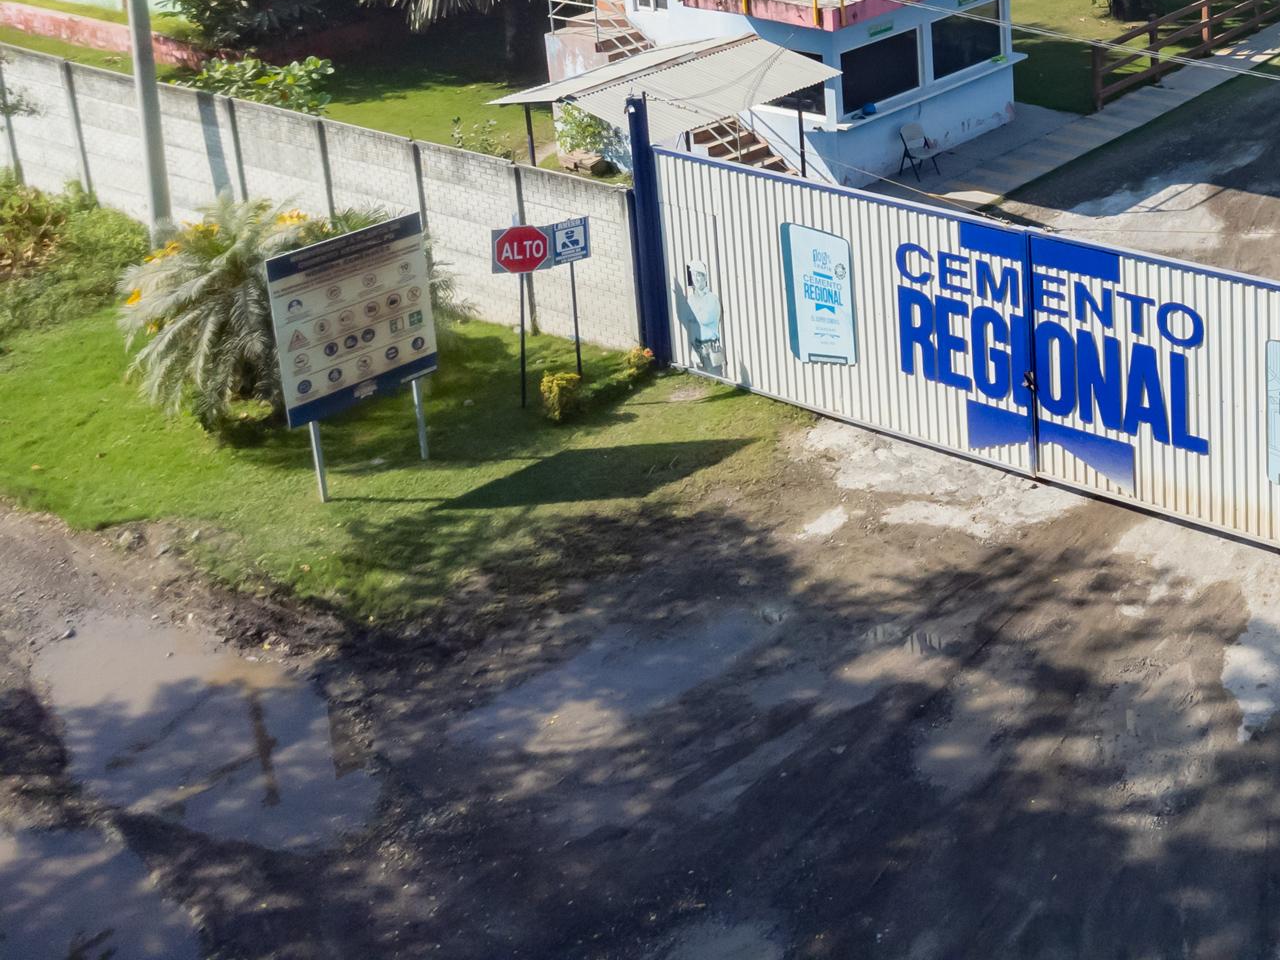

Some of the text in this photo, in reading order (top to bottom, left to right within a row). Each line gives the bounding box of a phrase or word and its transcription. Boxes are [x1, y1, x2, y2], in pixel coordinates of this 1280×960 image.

[501, 240, 544, 261] ALTO
[803, 273, 842, 291] CEMENTO
[803, 283, 844, 306] REGIONAL
[895, 242, 1204, 348] CEMENTO
[897, 284, 1209, 455] REGIONAL
